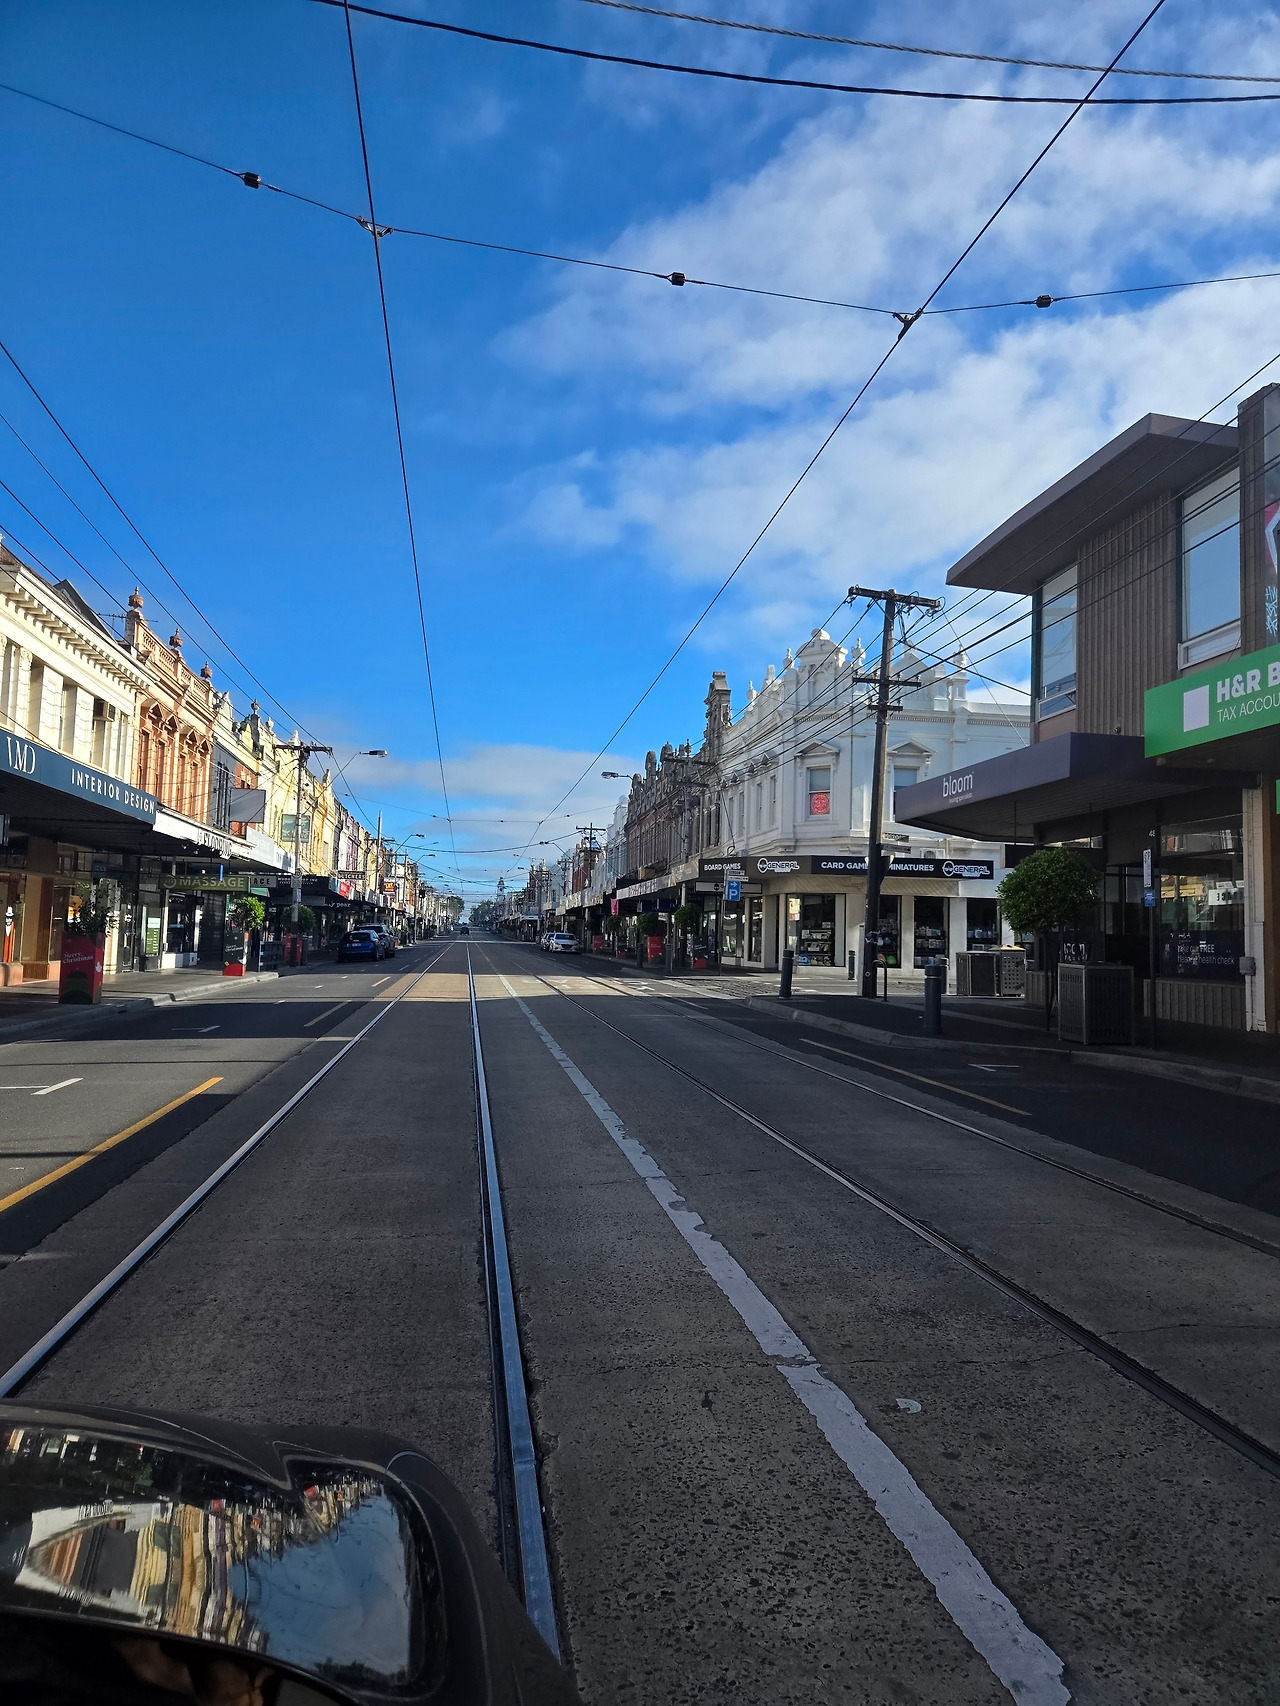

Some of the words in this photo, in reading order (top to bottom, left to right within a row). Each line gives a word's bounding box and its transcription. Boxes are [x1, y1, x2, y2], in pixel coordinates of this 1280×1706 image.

[1217, 669, 1261, 703] H&R
[1217, 705, 1237, 722] TAX
[72, 769, 120, 801] INTERIOR
[124, 790, 155, 814] DESIGN
[943, 775, 973, 797] bloom
[767, 861, 800, 870] GENERAL
[888, 864, 935, 872] MINIATURES
[953, 865, 991, 874] GENERAL
[179, 876, 245, 888] MASSAGE
[250, 878, 270, 886] ACE
[729, 888, 738, 899] P
[1200, 944, 1215, 953] FREE
